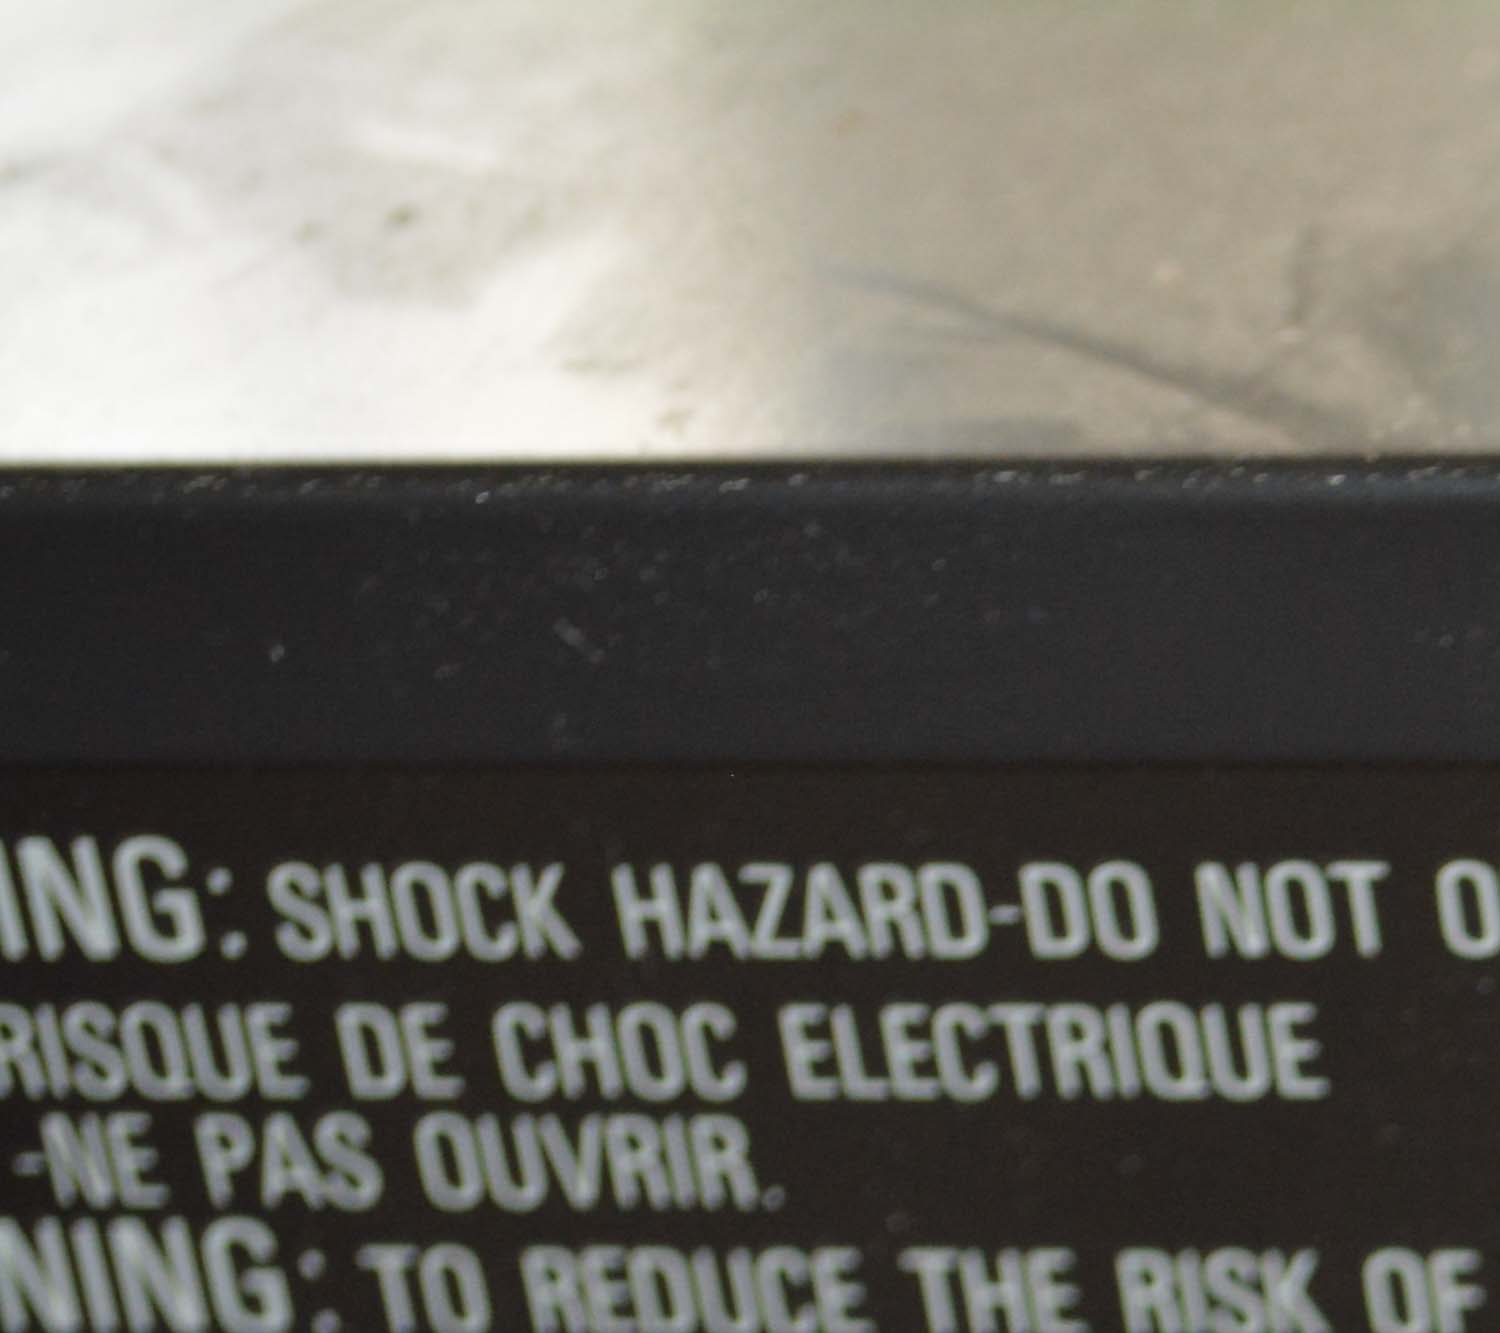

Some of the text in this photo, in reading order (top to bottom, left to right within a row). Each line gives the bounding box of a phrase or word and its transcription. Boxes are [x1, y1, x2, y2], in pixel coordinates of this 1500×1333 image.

[268, 862, 580, 960] SHOCK
[612, 861, 1158, 960] HAZARD-DO
[1195, 860, 1388, 959] NOT
[0, 1001, 1327, 1101] RISQUE DE CHOC ELECTRIQUE
[196, 1112, 382, 1210] PAS
[415, 1112, 780, 1210] OUVRIR.
